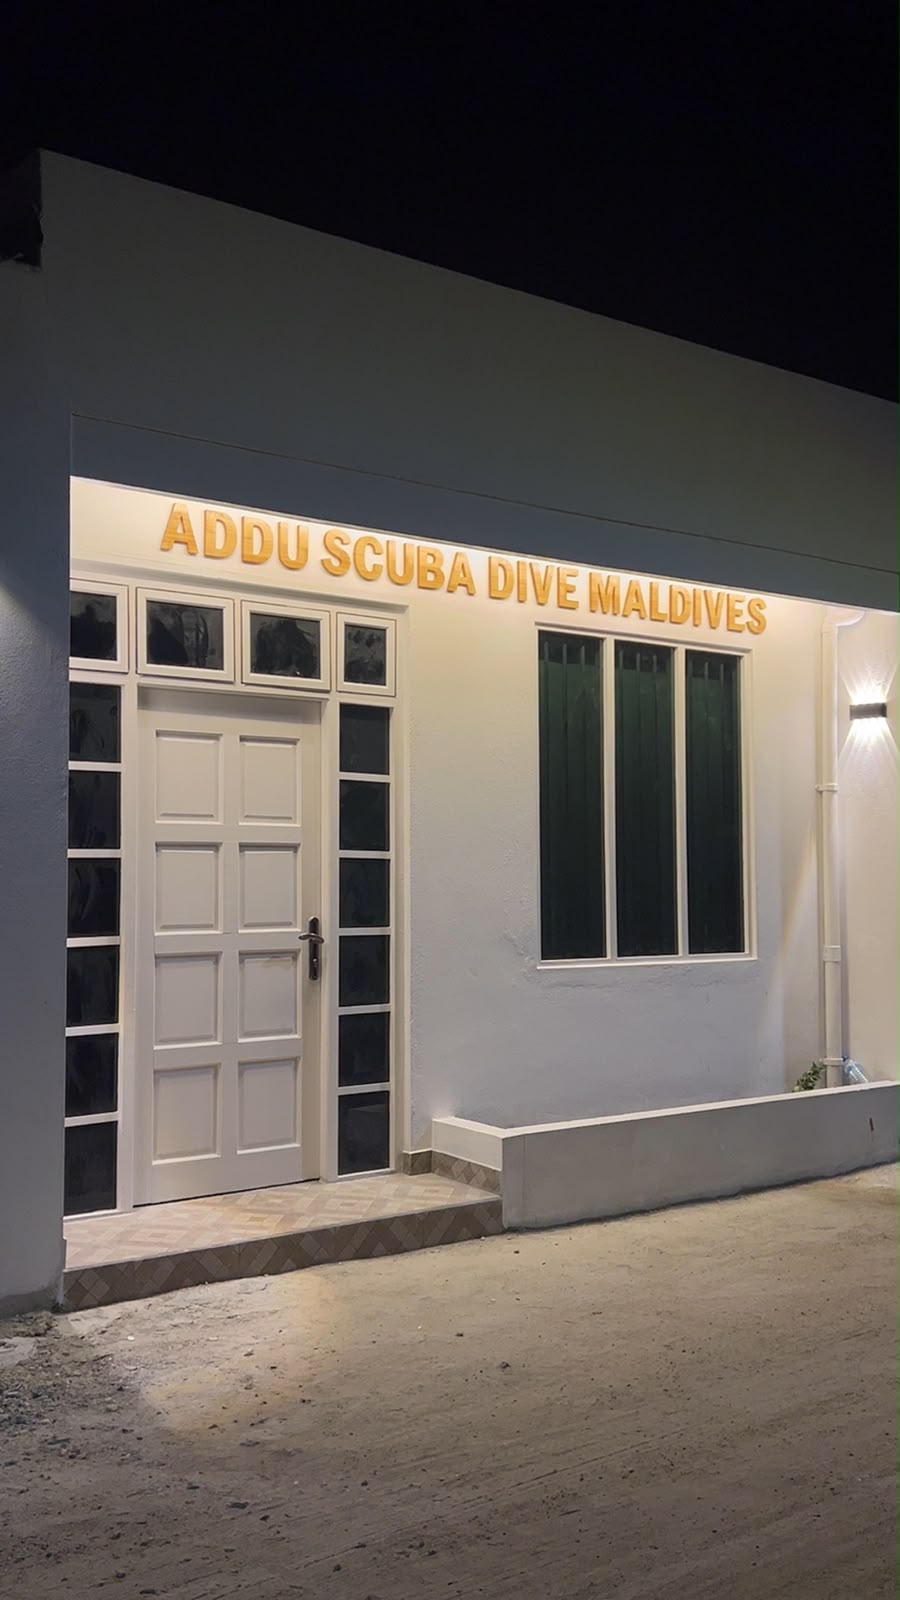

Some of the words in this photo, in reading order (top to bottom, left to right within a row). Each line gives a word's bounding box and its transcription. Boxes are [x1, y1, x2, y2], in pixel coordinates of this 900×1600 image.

[161, 503, 309, 570] ADDU
[321, 529, 477, 595] SCUBA
[488, 556, 579, 610] DIVE
[589, 572, 767, 634] MALDIVES
